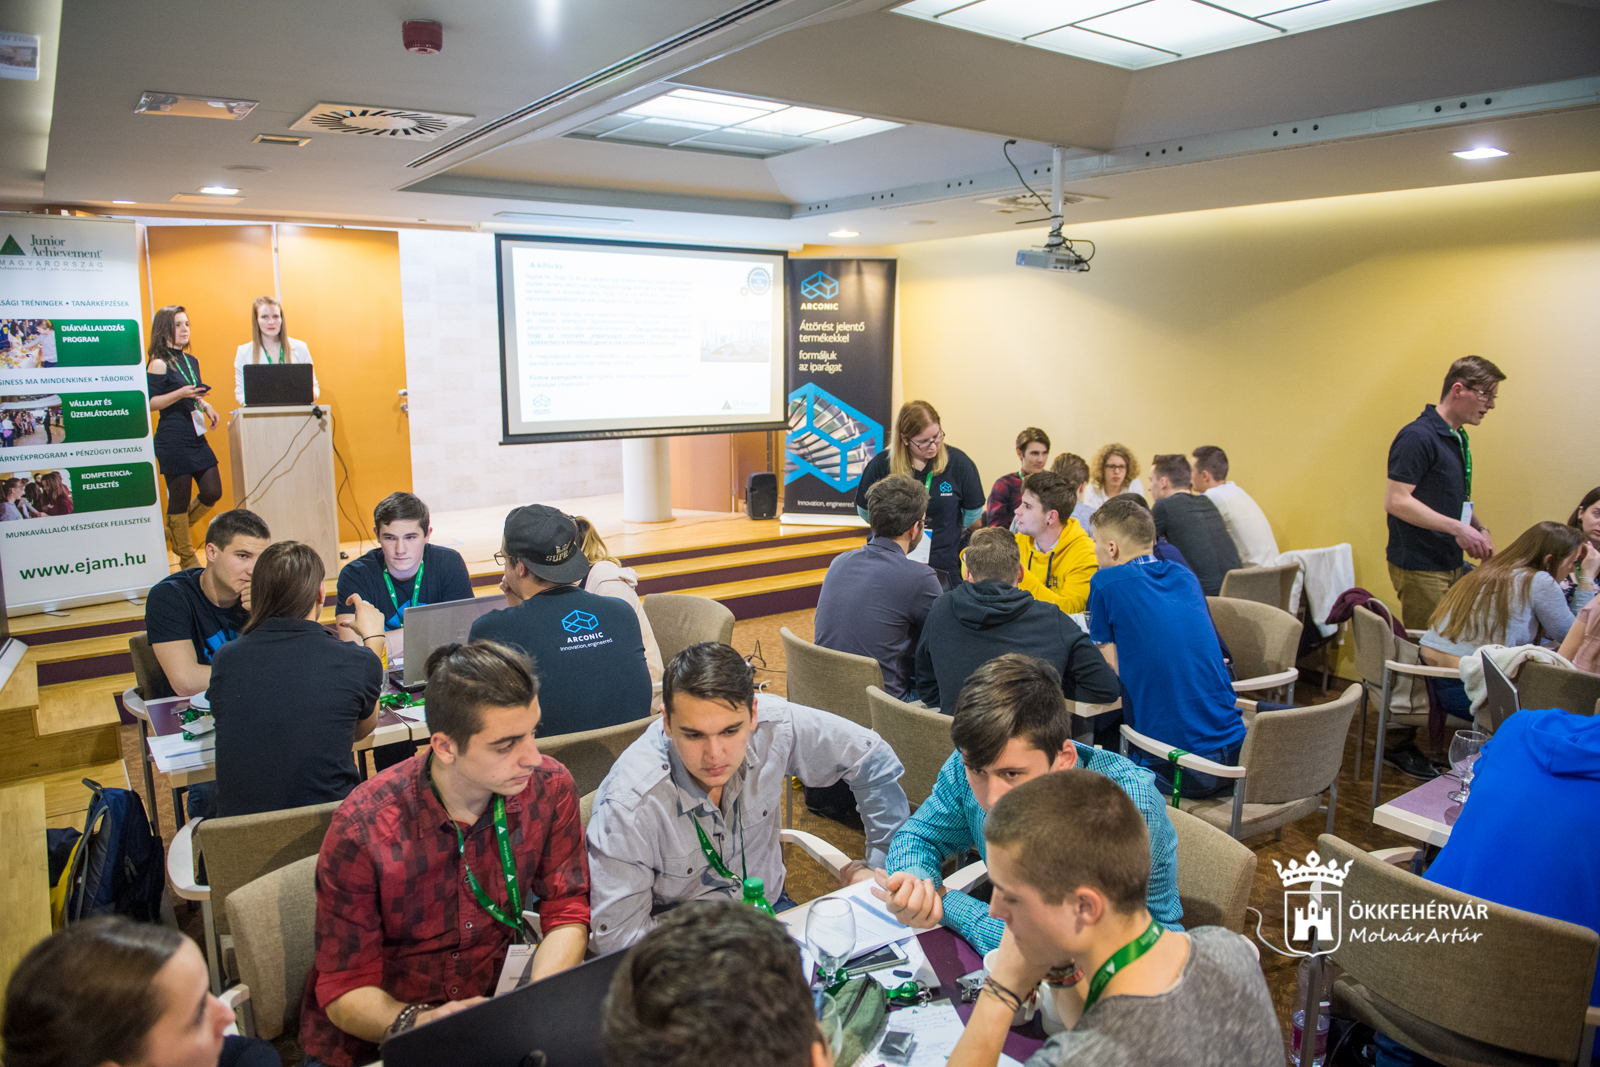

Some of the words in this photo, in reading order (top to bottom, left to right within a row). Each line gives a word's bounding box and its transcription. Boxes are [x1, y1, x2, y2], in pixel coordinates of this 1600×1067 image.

[30, 234, 66, 246] Junior
[31, 246, 100, 258] Achievement
[61, 324, 125, 332] DIÁKVÁLLALKOZÁS
[799, 320, 834, 331] Áttörést
[836, 322, 865, 333] jelentő
[799, 333, 850, 342] termékekkel
[799, 350, 837, 362] formáljuk
[810, 362, 842, 374] iparágat
[70, 408, 130, 418] ÜZEMLÁTOGATÁS
[76, 448, 111, 456] PÉNZÜGYI
[81, 470, 132, 480] KOMPETENCIA-
[82, 481, 120, 490] FEJLESZTÉS
[6, 526, 69, 538] MUNKAVÁLLALÓI
[70, 521, 110, 531] KÉSZSÉGEK
[110, 516, 152, 527] FEJLESZTÉSE
[19, 552, 146, 580] www.ejam.hu
[566, 632, 604, 643] ARCONIC
